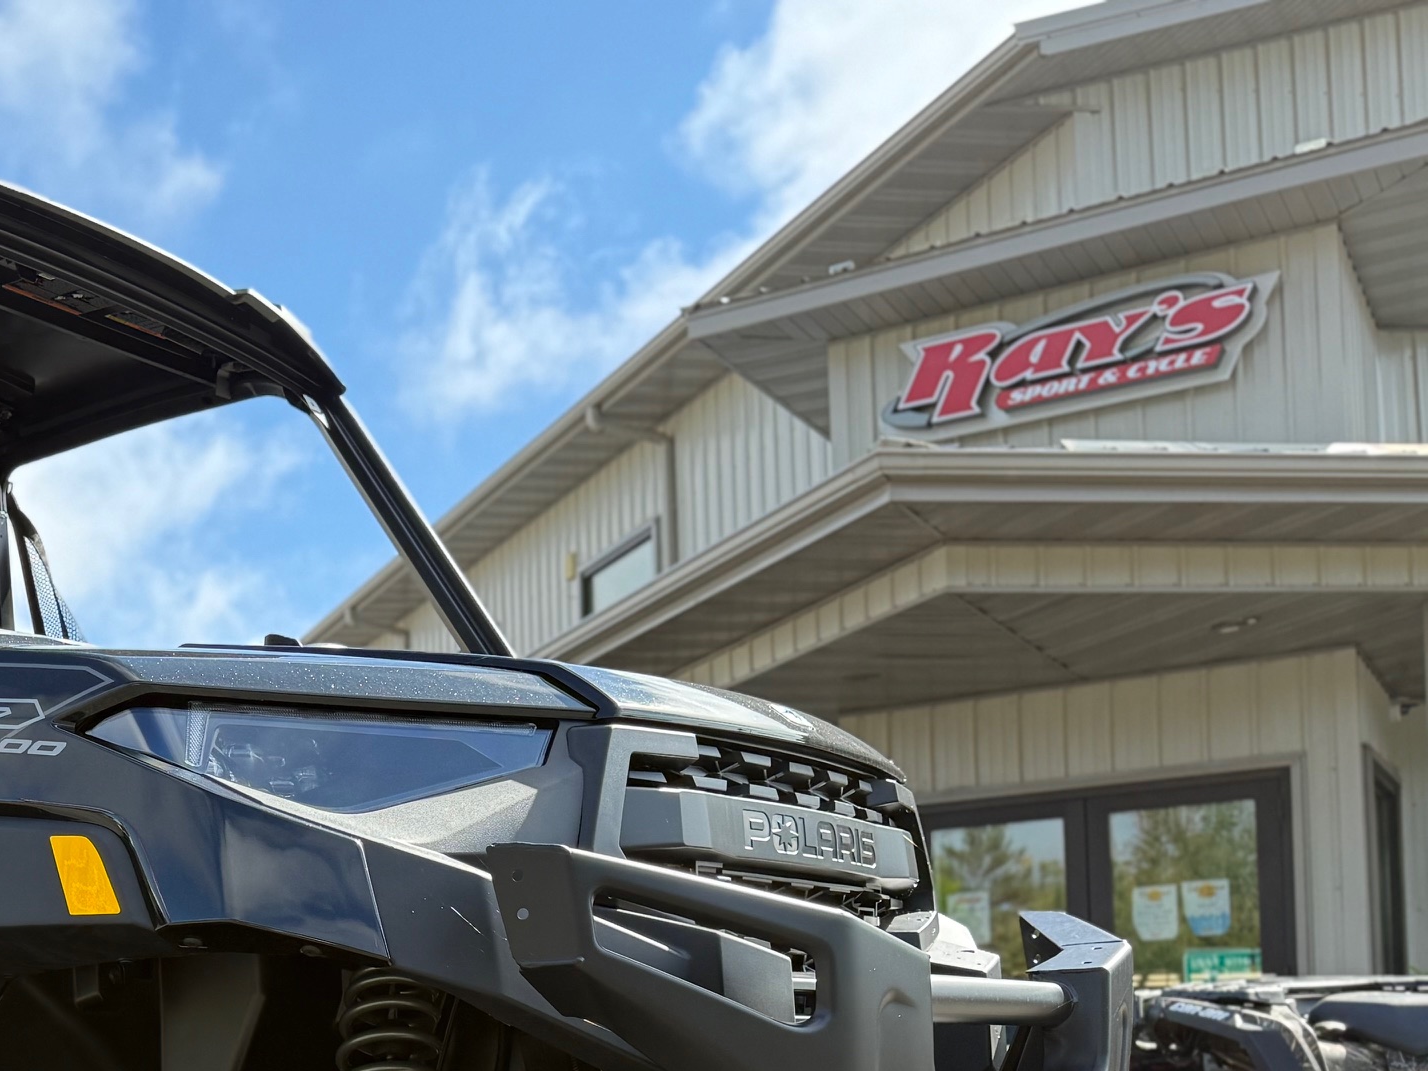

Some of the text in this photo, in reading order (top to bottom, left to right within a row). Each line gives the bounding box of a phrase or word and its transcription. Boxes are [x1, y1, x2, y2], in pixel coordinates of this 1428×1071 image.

[1006, 347, 1212, 405] SPORT & CYCLE
[742, 809, 876, 869] POLARIS
